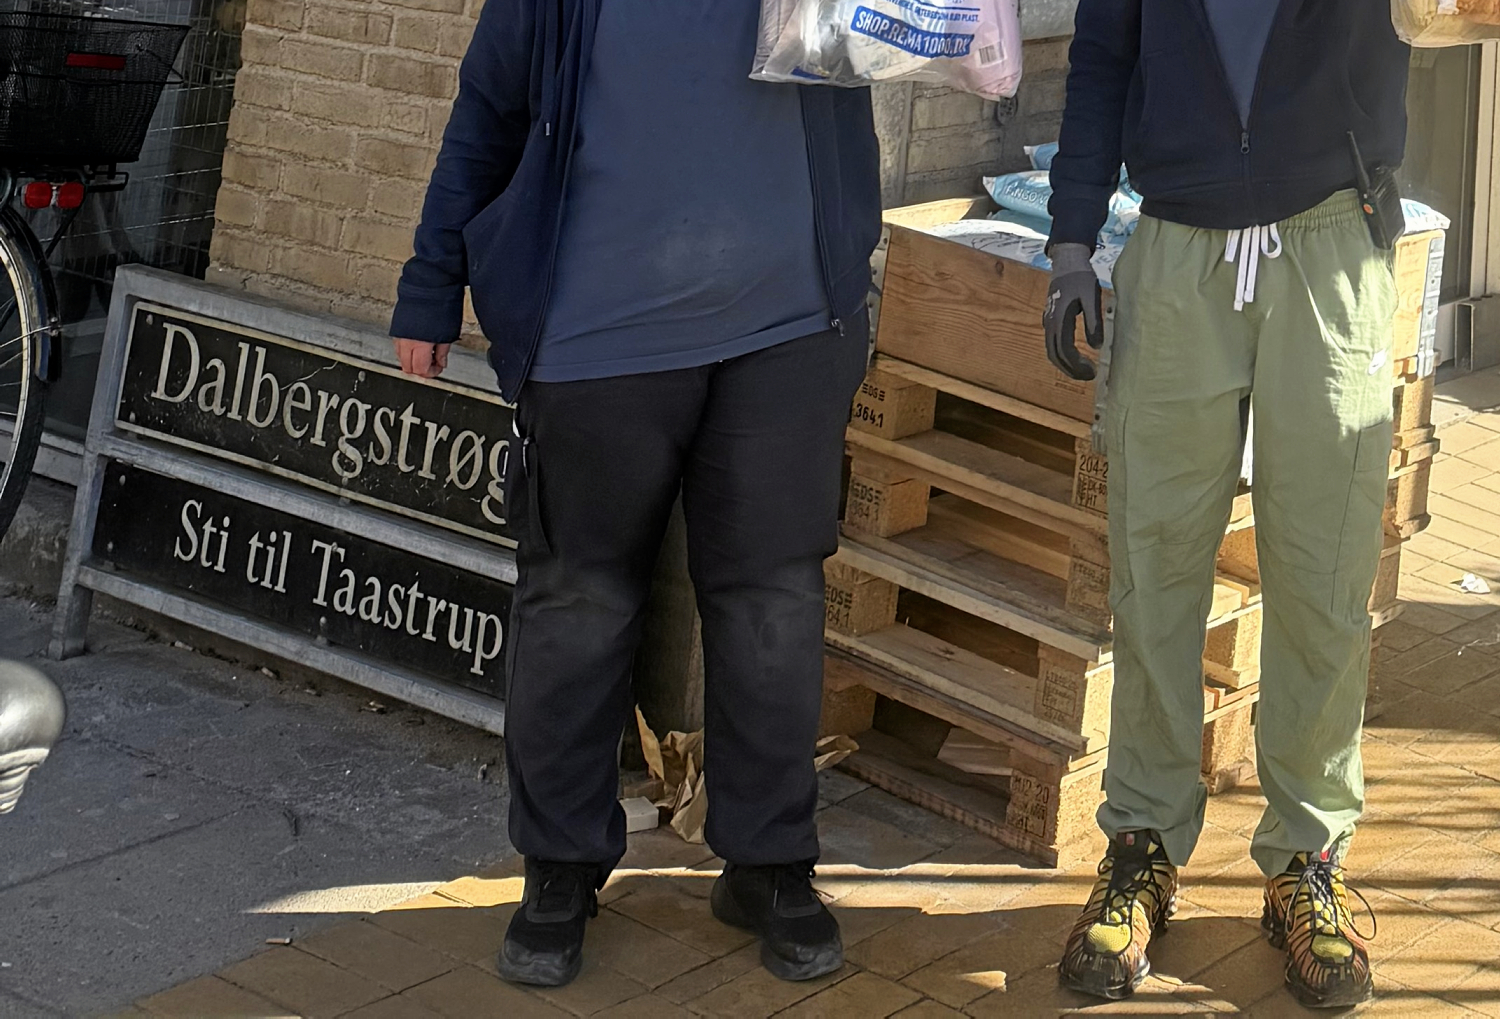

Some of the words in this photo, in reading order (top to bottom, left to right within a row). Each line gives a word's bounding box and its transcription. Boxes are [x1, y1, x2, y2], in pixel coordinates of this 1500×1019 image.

[174, 499, 230, 573] Sti
[246, 531, 292, 595] til
[311, 539, 502, 676] Taastrup
